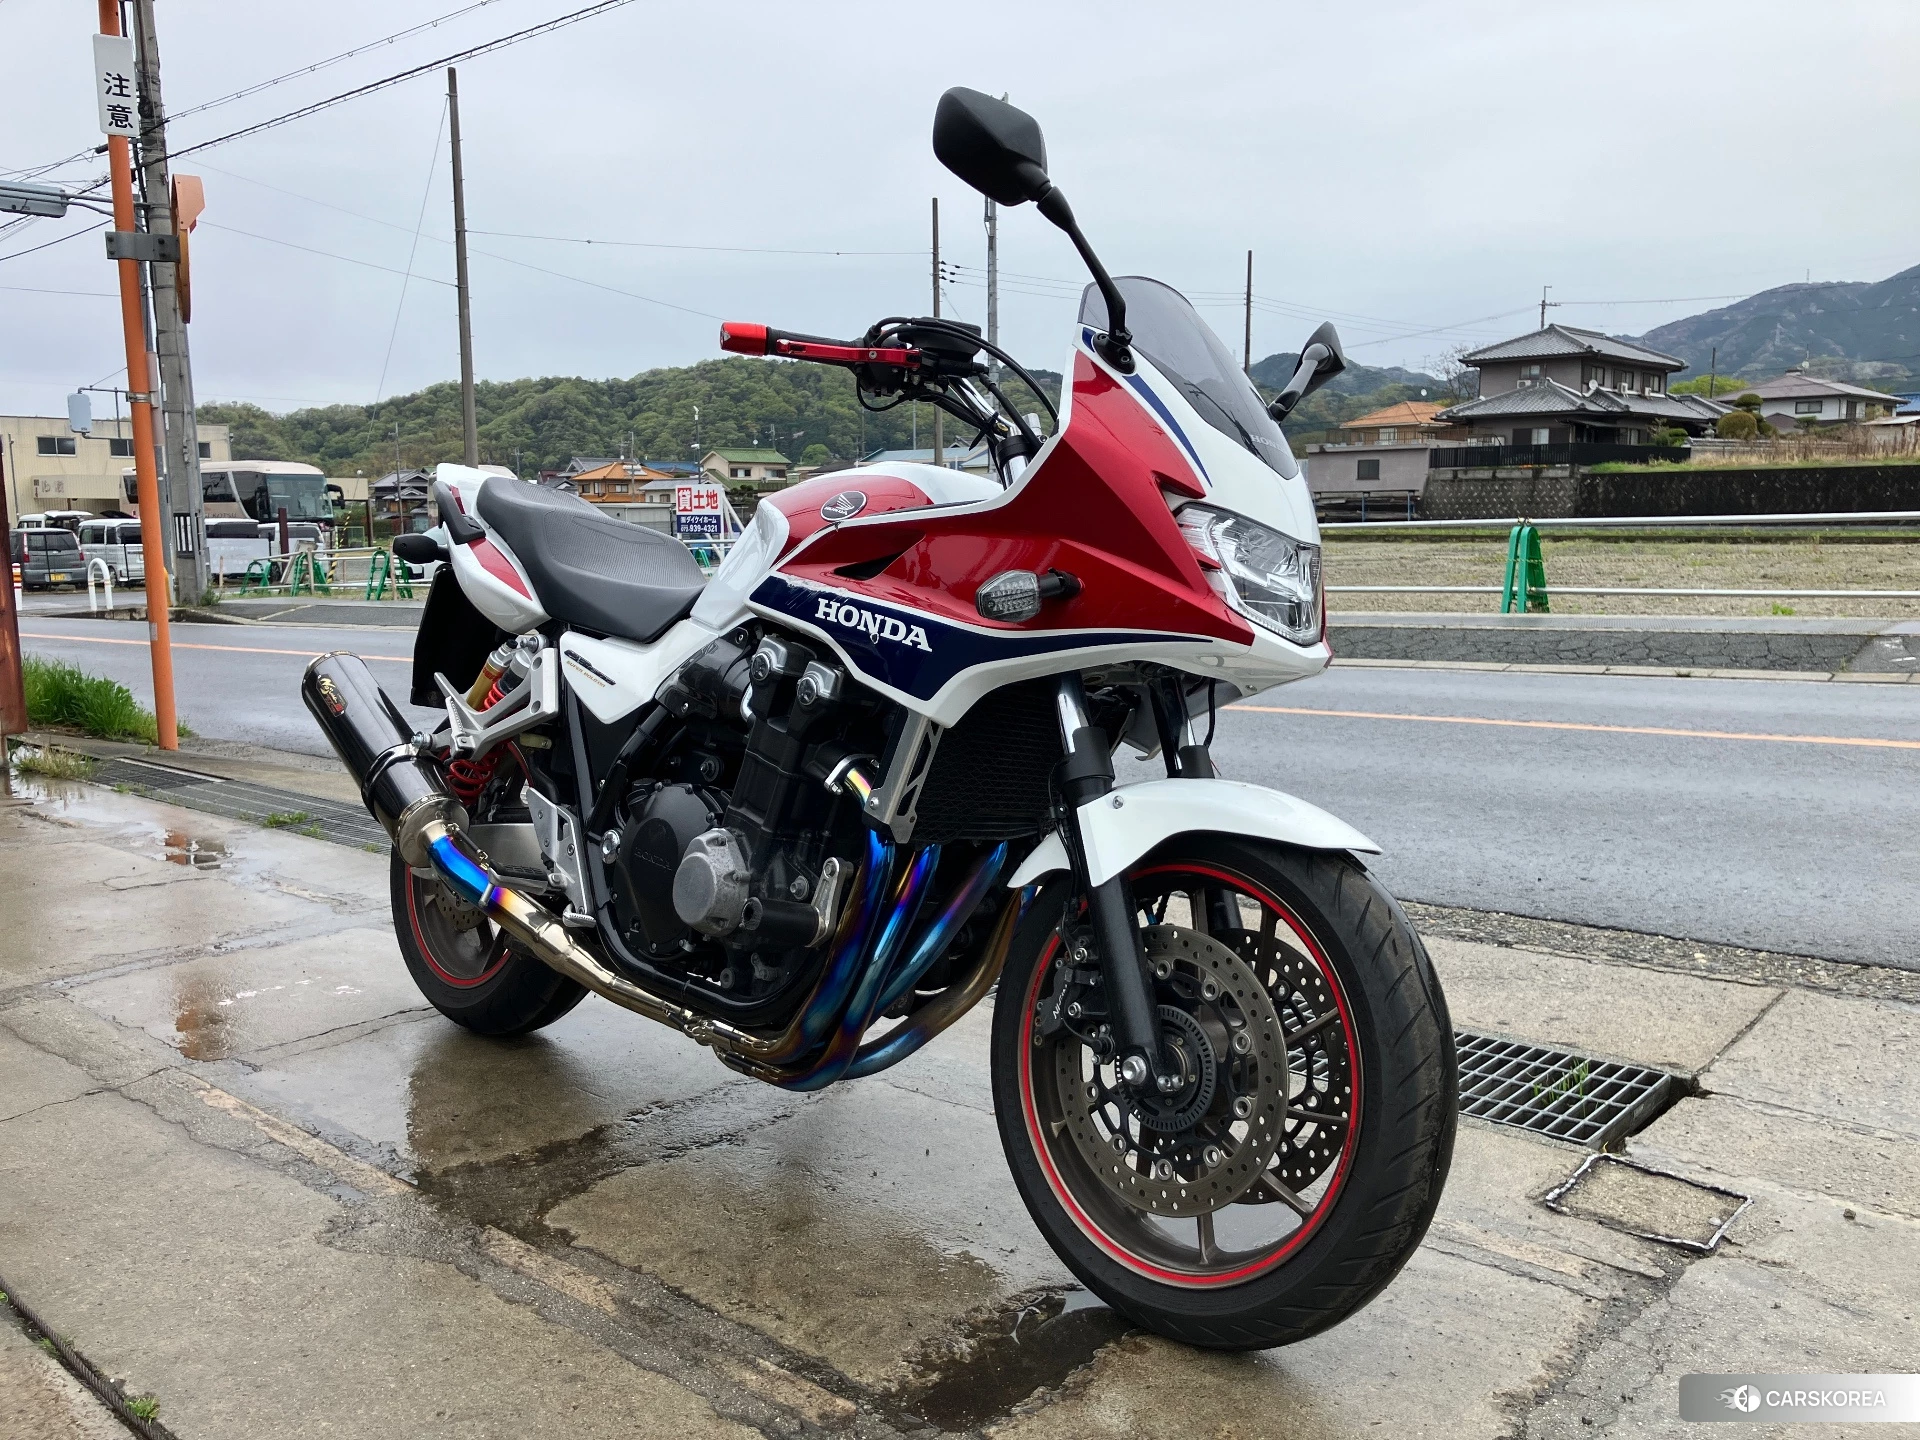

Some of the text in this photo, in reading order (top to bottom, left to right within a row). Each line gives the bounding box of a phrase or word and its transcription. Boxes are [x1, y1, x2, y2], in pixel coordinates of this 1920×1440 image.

[103, 72, 133, 128] 注意
[678, 488, 718, 511] 貸土地
[814, 597, 933, 652] HONDA
